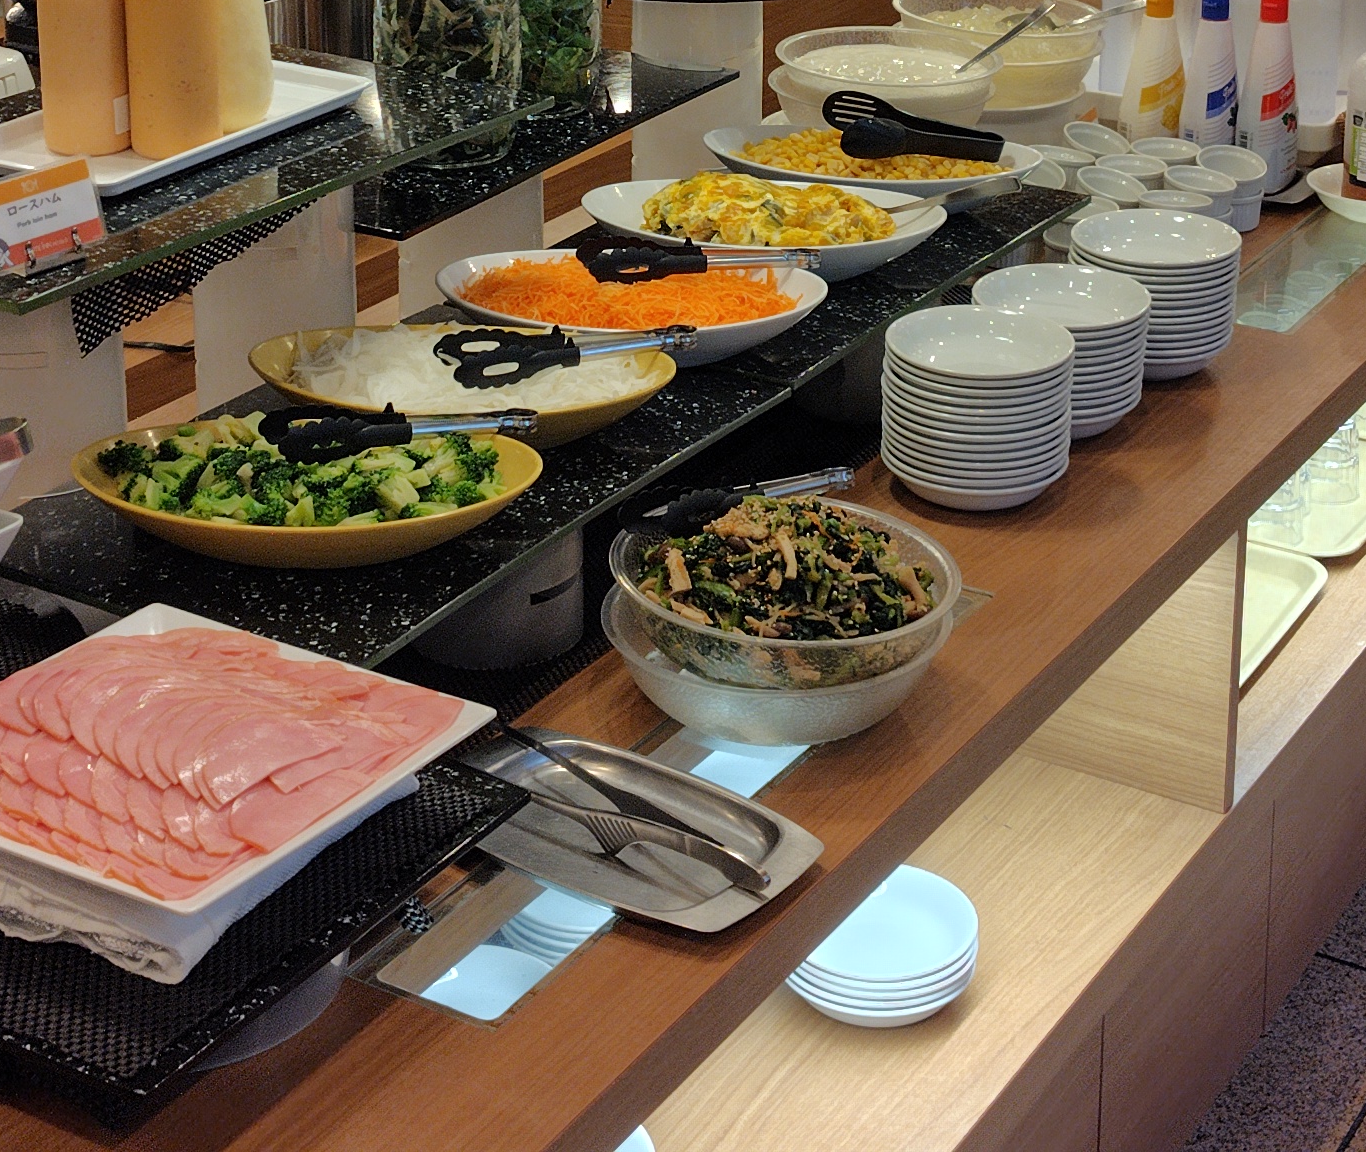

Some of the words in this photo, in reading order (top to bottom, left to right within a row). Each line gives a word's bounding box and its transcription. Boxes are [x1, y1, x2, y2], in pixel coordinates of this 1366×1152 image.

[7, 192, 62, 217] ロースハム
